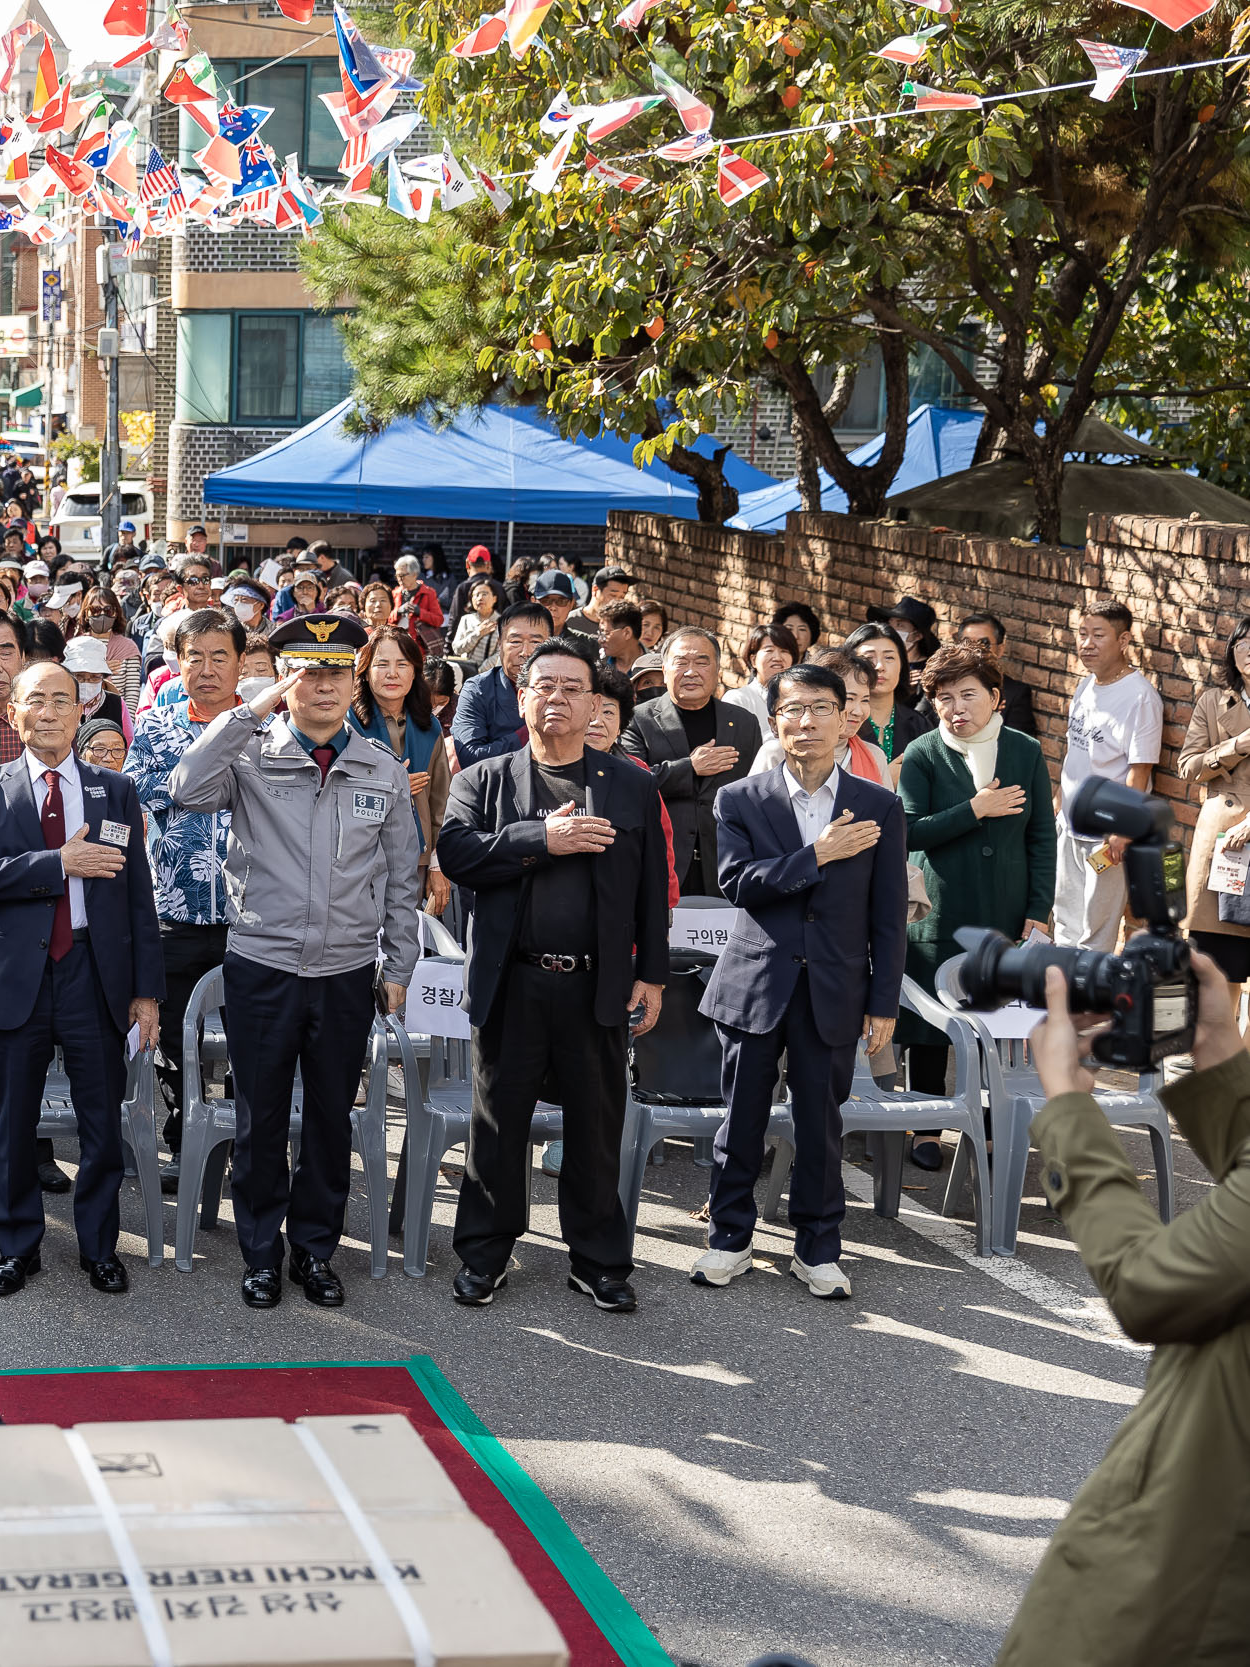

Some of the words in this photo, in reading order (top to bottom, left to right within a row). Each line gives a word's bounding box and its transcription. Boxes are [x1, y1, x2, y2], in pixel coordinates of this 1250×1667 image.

[357, 794, 382, 811] 경찰
[356, 808, 382, 819] POLICE
[686, 929, 729, 945] 구의원
[265, 1563, 421, 1583] KMCHI
[163, 1594, 248, 1621] 김치
[260, 1591, 343, 1614] 삼성
